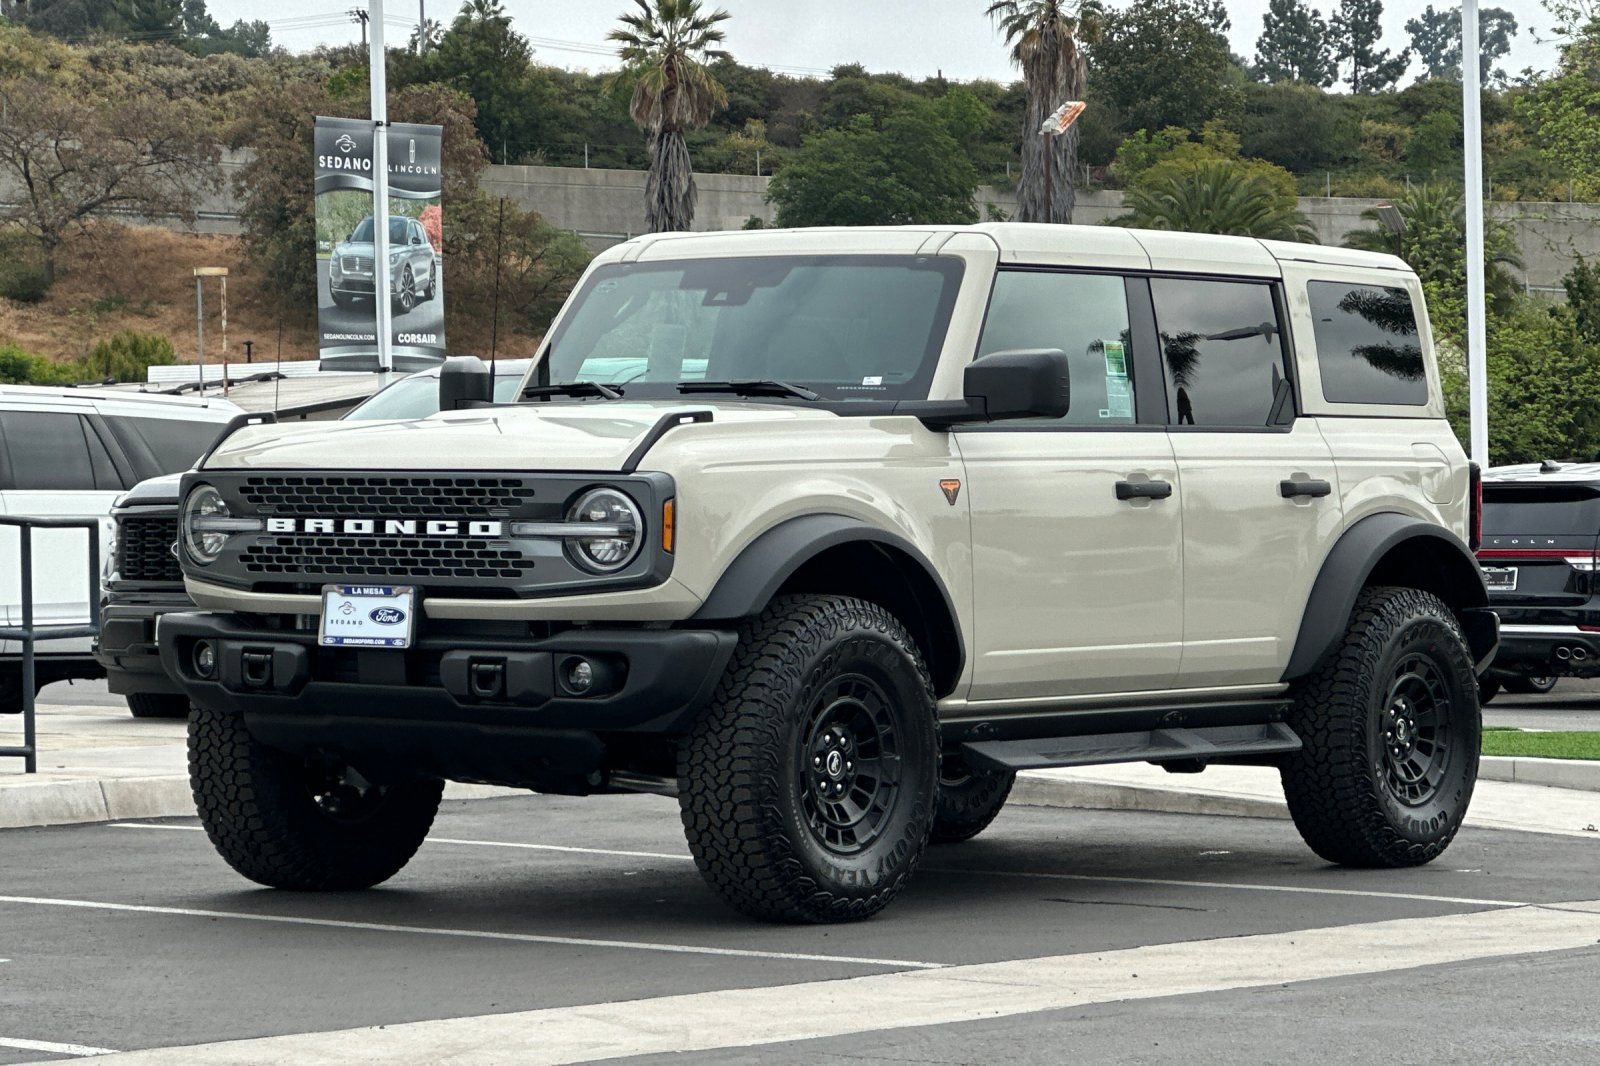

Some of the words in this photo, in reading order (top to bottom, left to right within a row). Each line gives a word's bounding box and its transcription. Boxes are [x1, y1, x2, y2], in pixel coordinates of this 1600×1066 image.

[319, 155, 371, 171] SEDANO
[388, 164, 437, 175] LINCOLN
[323, 333, 376, 341] SEDANOLINCOLN.COM
[398, 333, 437, 344] CORSAIR
[267, 518, 502, 535] BRONCO
[375, 609, 400, 623] Ford
